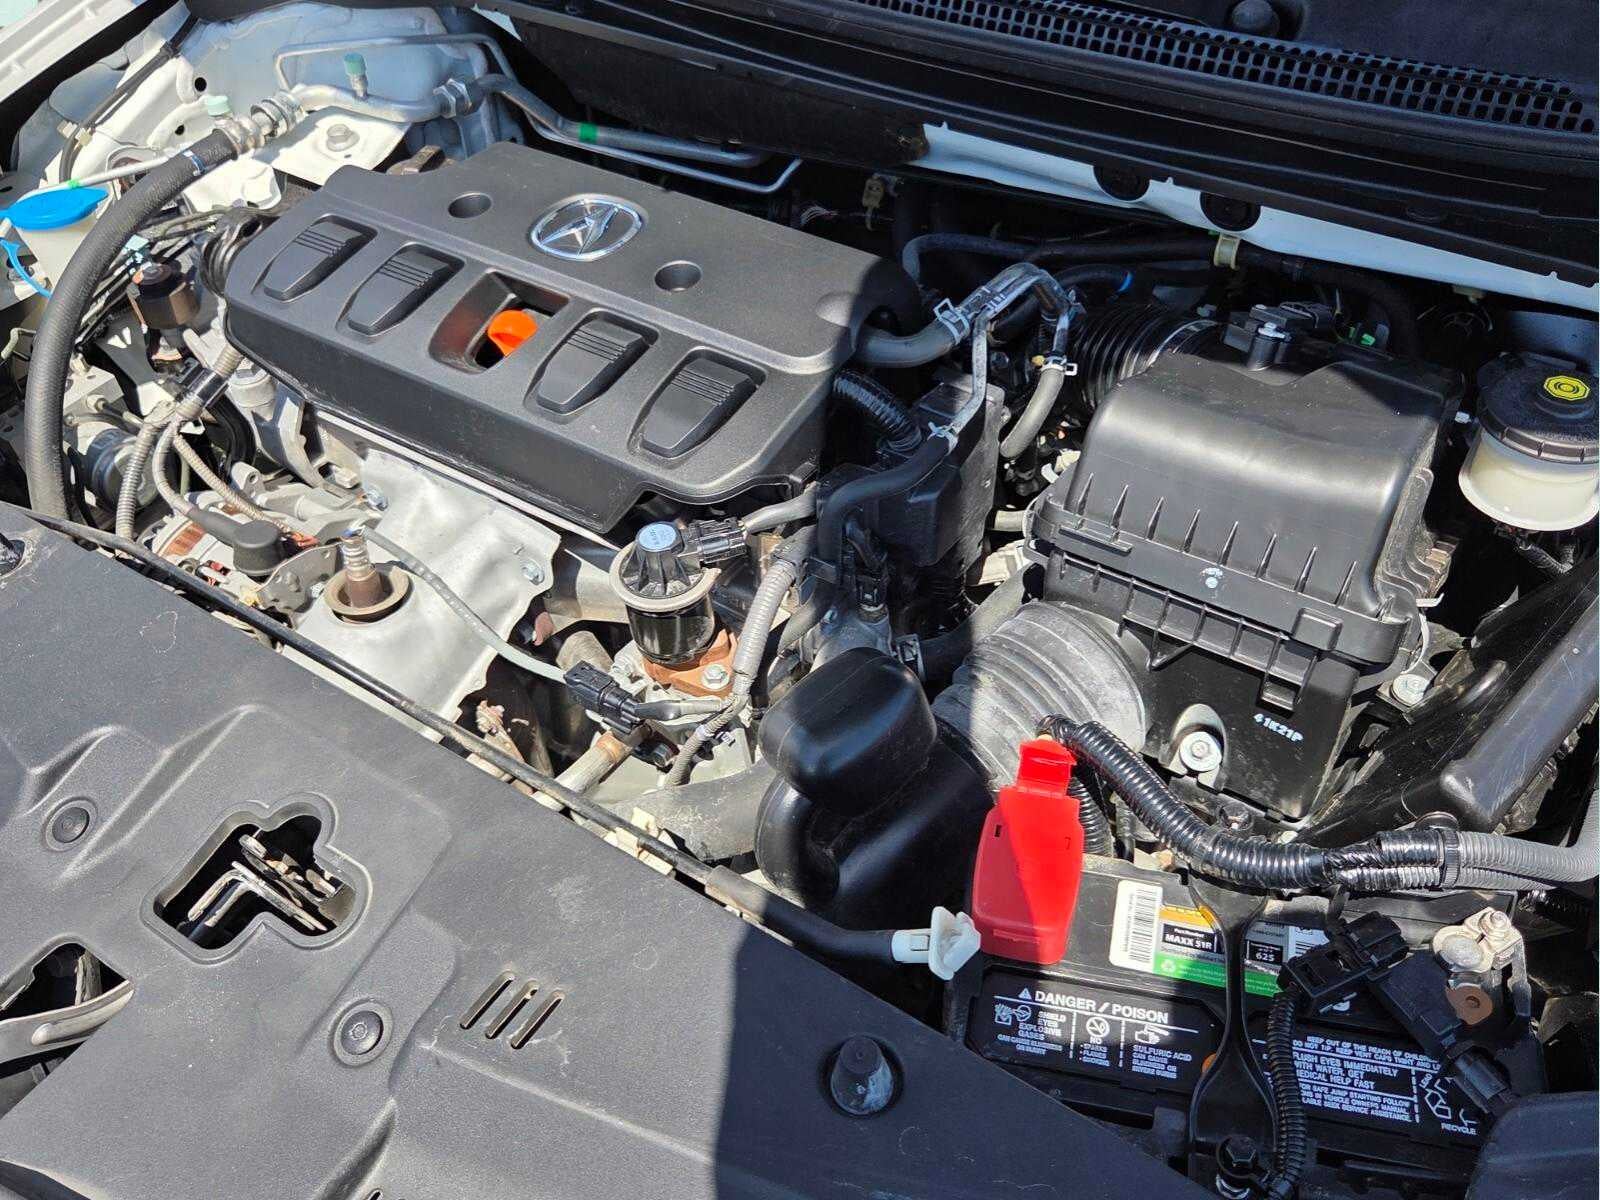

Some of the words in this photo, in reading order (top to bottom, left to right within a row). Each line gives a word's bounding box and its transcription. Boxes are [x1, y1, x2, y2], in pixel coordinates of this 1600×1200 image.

[1165, 933, 1194, 946] MAXX
[1255, 951, 1276, 962] 625
[1034, 990, 1097, 1012] DANGER
[1111, 1003, 1169, 1025] POISON
[1037, 1018, 1059, 1028] EYES
[1038, 1010, 1067, 1023] SHIELD
[1018, 1022, 1062, 1037] EXPLOSIVE
[1018, 1030, 1045, 1041] GASES
[1090, 1036, 1102, 1045] NO
[1133, 1044, 1172, 1058] SULFURIC
[1172, 1052, 1192, 1062] ACID
[1293, 1039, 1303, 1047] DO
[1304, 1041, 1319, 1049] NOT
[1354, 1050, 1372, 1058] VENT
[1325, 1039, 1340, 1047] OUT
[1352, 1043, 1367, 1052] THE
[1368, 1046, 1392, 1056] REACH
[1392, 1049, 1402, 1057] OF
[1320, 1056, 1341, 1067] EYES
[1343, 1060, 1399, 1077] IMMEDIATELY
[1347, 1068, 1365, 1079] GET
[1329, 1074, 1352, 1086] HELP
[1353, 1078, 1375, 1090] FAST
[1323, 1094, 1350, 1105] VEHICLE
[1382, 1097, 1411, 1108] FOLLOW
[1441, 1122, 1477, 1135] RECYCLE
